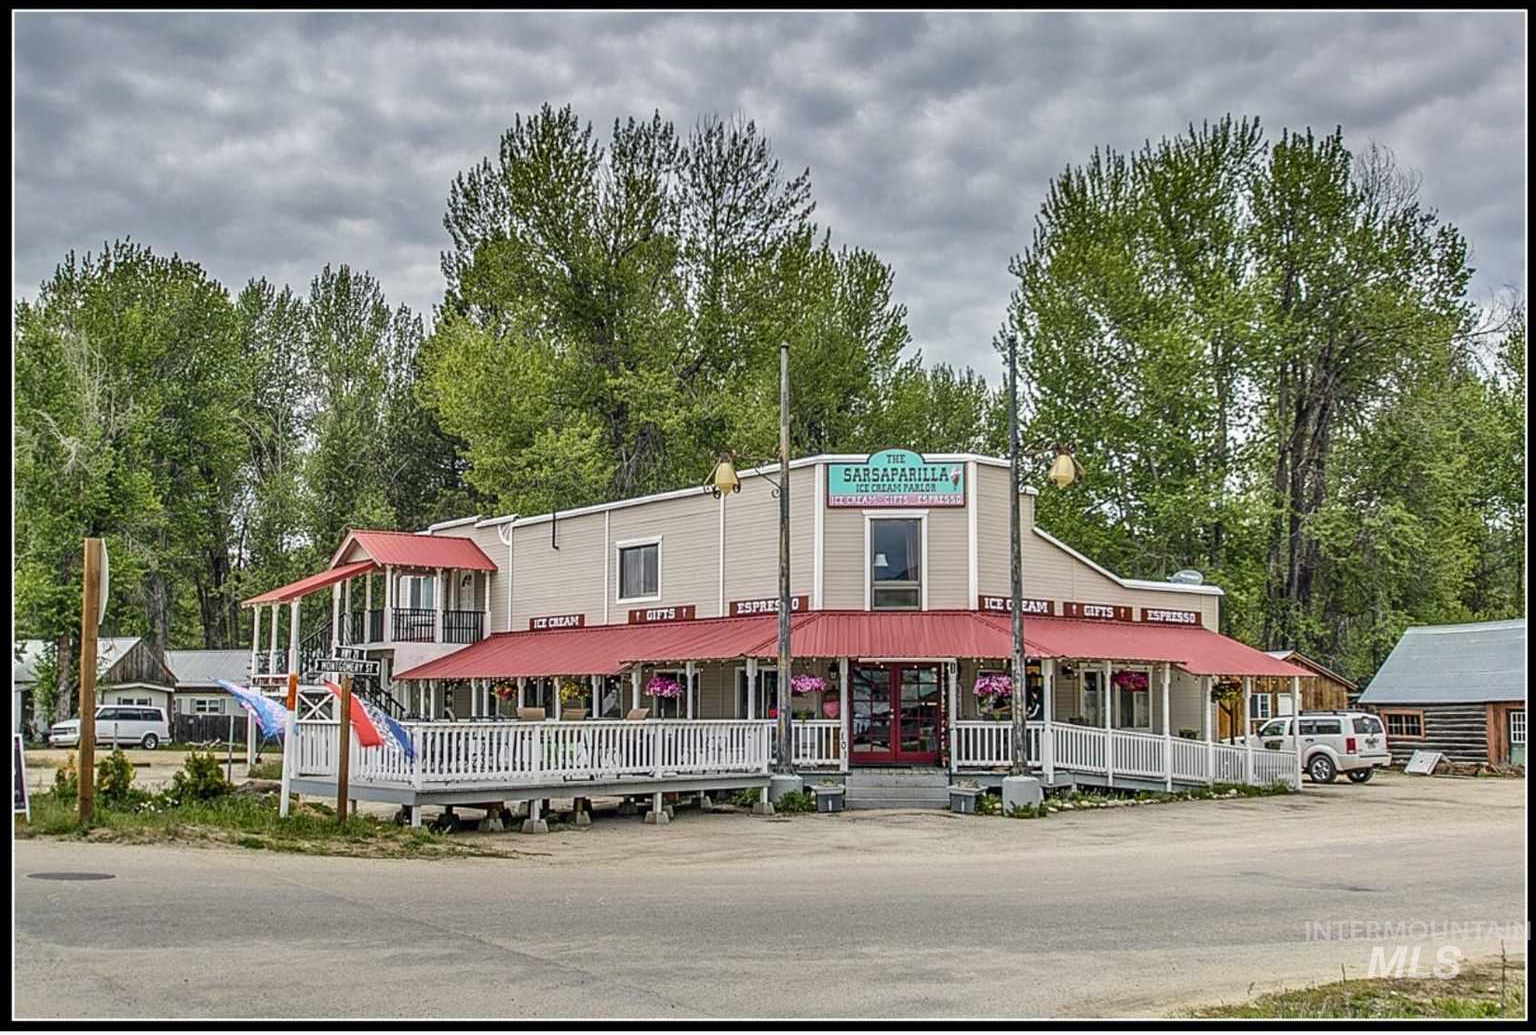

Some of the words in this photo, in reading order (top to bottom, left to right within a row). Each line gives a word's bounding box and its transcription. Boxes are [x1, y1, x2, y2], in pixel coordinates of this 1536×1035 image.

[886, 454, 906, 464] THE
[843, 467, 950, 483] SARSAPARILLA
[855, 483, 870, 493] ICE
[871, 483, 902, 493] CREAM
[903, 483, 937, 493] PARLOR
[736, 598, 800, 615] ESPRESO
[984, 596, 1004, 611] ICE
[1006, 598, 1049, 614] CEAM
[1084, 605, 1115, 618] GIFTS
[646, 608, 676, 621] GIFTS
[1146, 610, 1197, 623] ESPRESSO
[533, 618, 547, 629] ICE
[548, 616, 579, 628] CREAM
[321, 660, 364, 672] MONTGOMERY
